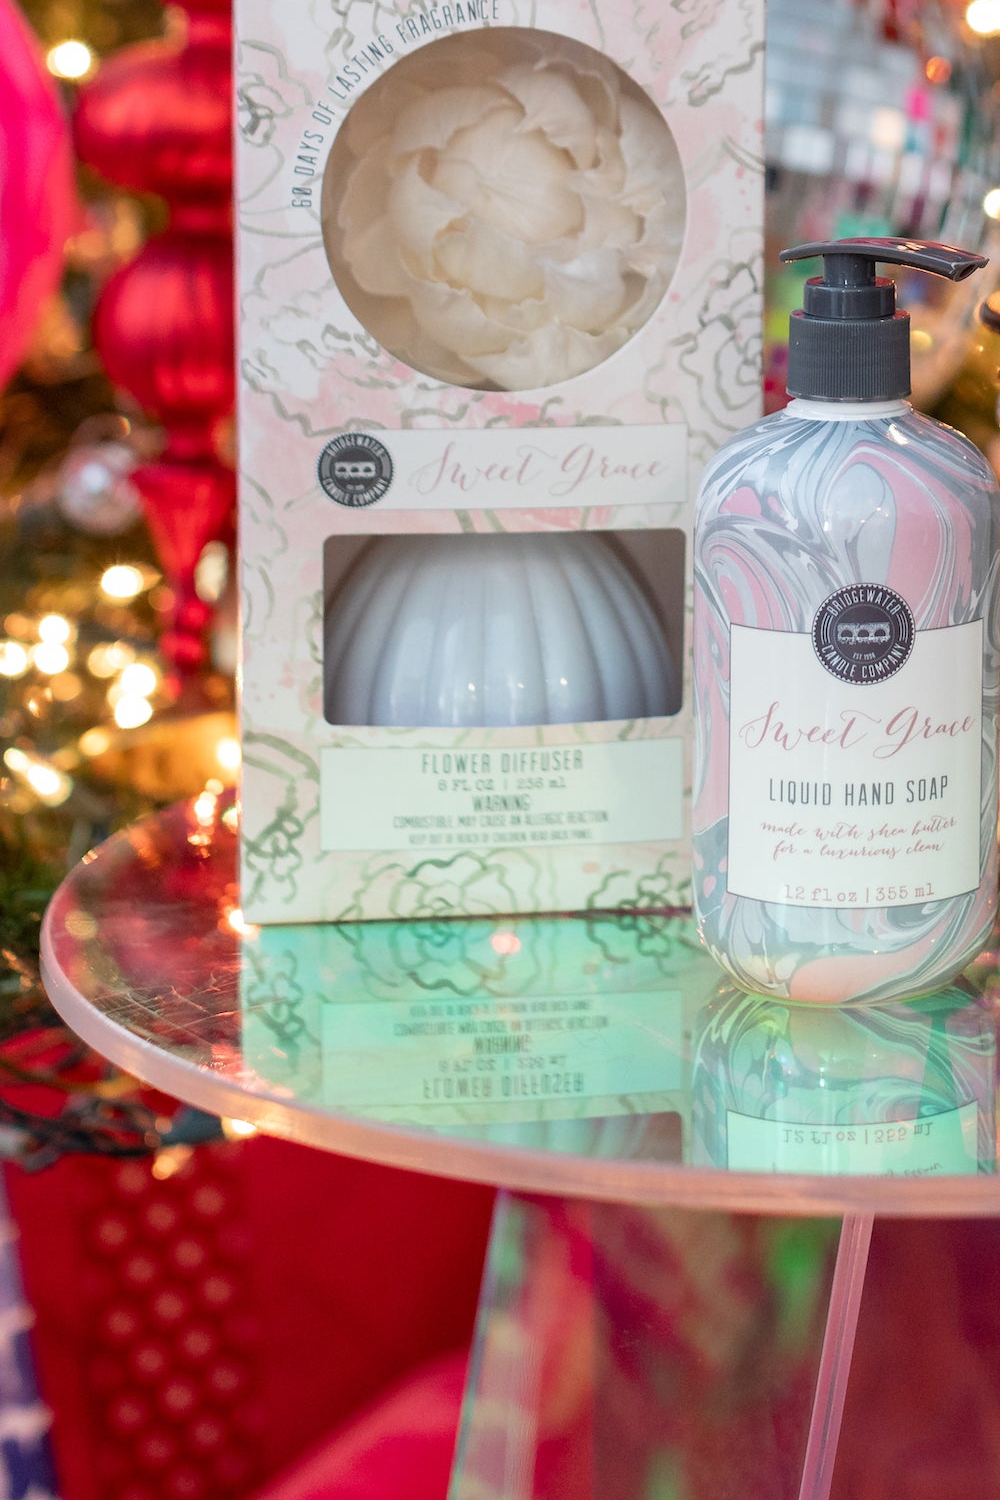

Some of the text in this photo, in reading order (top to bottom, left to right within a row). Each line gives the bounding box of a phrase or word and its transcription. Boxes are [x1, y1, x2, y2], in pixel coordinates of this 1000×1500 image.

[328, 34, 394, 100] LASTING
[312, 101, 336, 125] OF
[294, 130, 324, 176] DAYS
[292, 187, 312, 208] 60
[408, 441, 669, 497] Sweet Grace
[826, 589, 901, 617] BRIDGEWATER
[821, 643, 906, 678] CANDLE COMPANY
[738, 701, 977, 759] Sweet Grace
[421, 749, 583, 775] FLOWER DIFFUSER
[472, 794, 531, 812] WARNING
[769, 775, 949, 806] LIQUID HAND SOAP
[760, 816, 957, 842] made with shea butter
[773, 840, 945, 861] for a luxurious clean
[784, 884, 806, 901] 12
[811, 885, 831, 902] fl
[836, 890, 858, 902] oz
[875, 885, 909, 902] 355
[914, 883, 935, 899] ml
